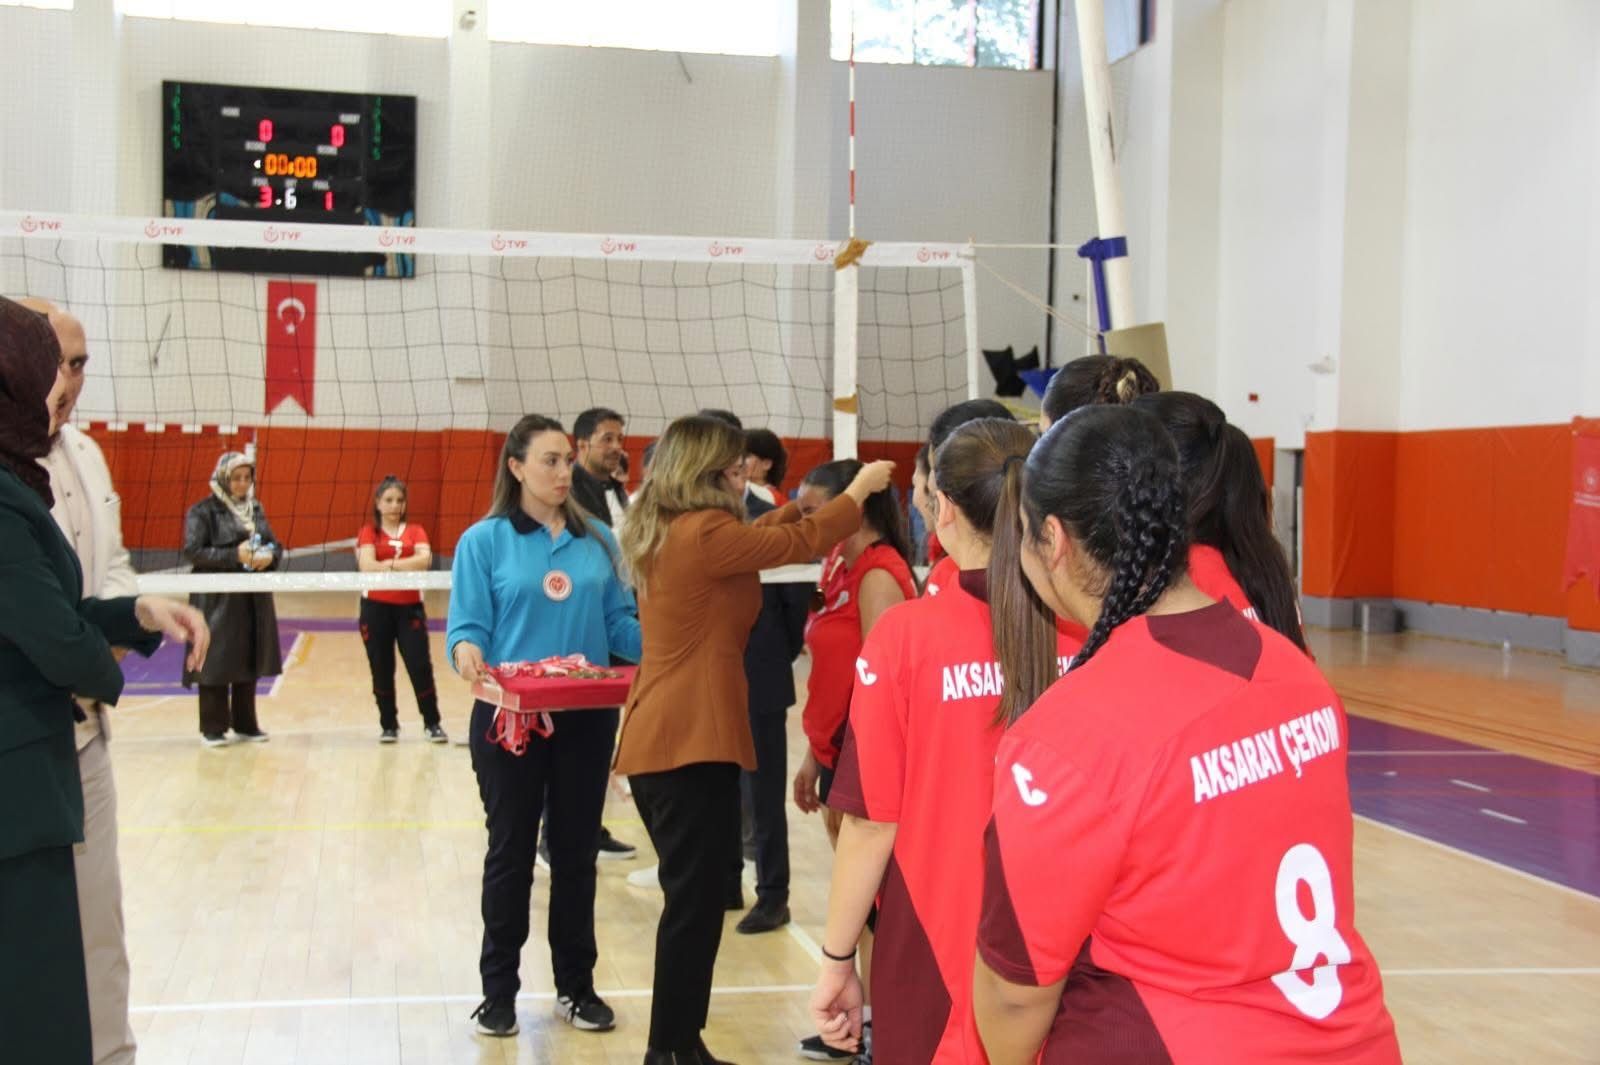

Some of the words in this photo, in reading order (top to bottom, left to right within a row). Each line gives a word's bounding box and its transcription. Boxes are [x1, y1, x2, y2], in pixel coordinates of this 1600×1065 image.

[259, 119, 273, 143] 0
[331, 124, 345, 148] 0
[265, 153, 317, 178] 00:00
[259, 186, 273, 208] 3
[285, 188, 297, 210] 6
[325, 191, 333, 211] 1
[39, 221, 63, 230] TVF
[161, 226, 183, 235] TVF
[280, 231, 301, 240] TVF
[396, 235, 416, 245] TVF
[507, 240, 528, 249] TVF
[617, 243, 637, 251] TVF
[724, 246, 743, 255] TVF
[1190, 728, 1283, 804] AKSARAY
[1271, 843, 1352, 1020] 8
